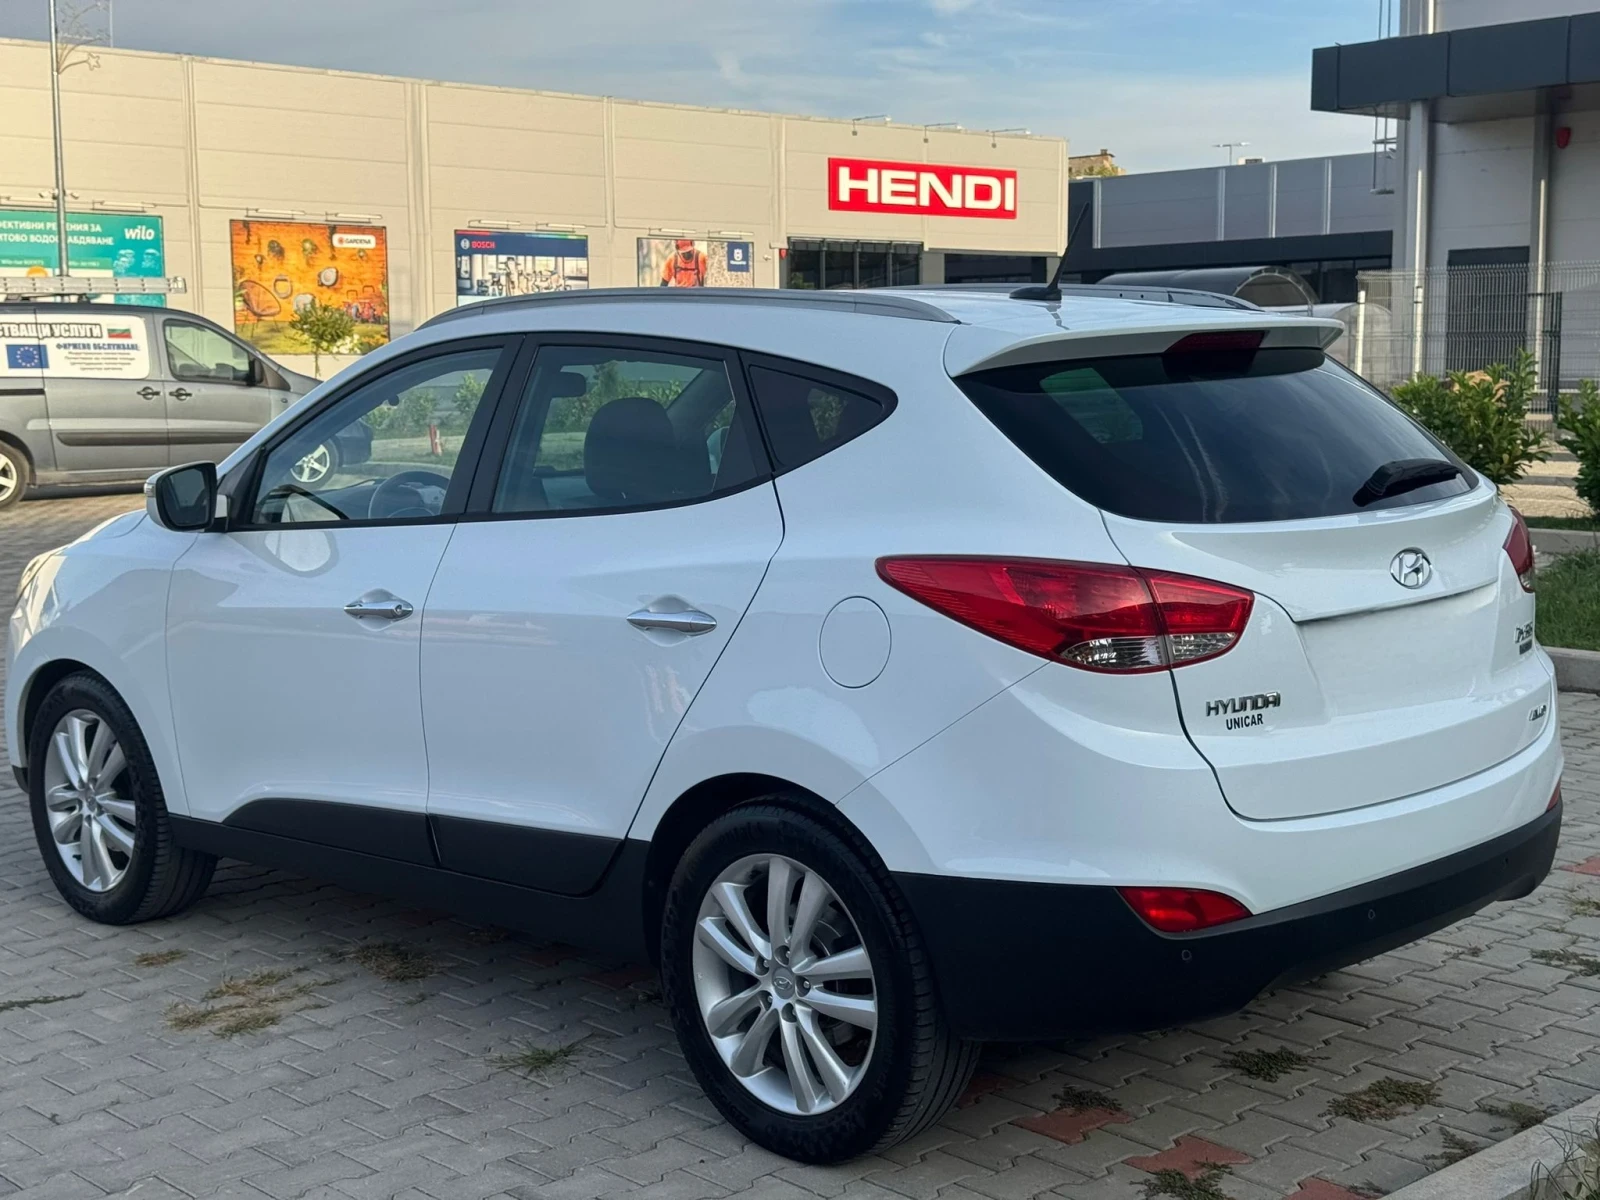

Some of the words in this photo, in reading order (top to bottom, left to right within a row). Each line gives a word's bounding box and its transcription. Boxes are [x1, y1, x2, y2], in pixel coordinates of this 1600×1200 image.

[838, 166, 1015, 211] HENDI
[46, 221, 88, 231] РЕЕНИЯ
[90, 223, 102, 232] ЗА
[124, 225, 155, 241] wilo
[471, 241, 496, 249] BOSCH
[52, 323, 102, 339] УСЛУГИ
[1205, 691, 1281, 717] HYUNDAI
[1225, 713, 1264, 730] UNICAR
